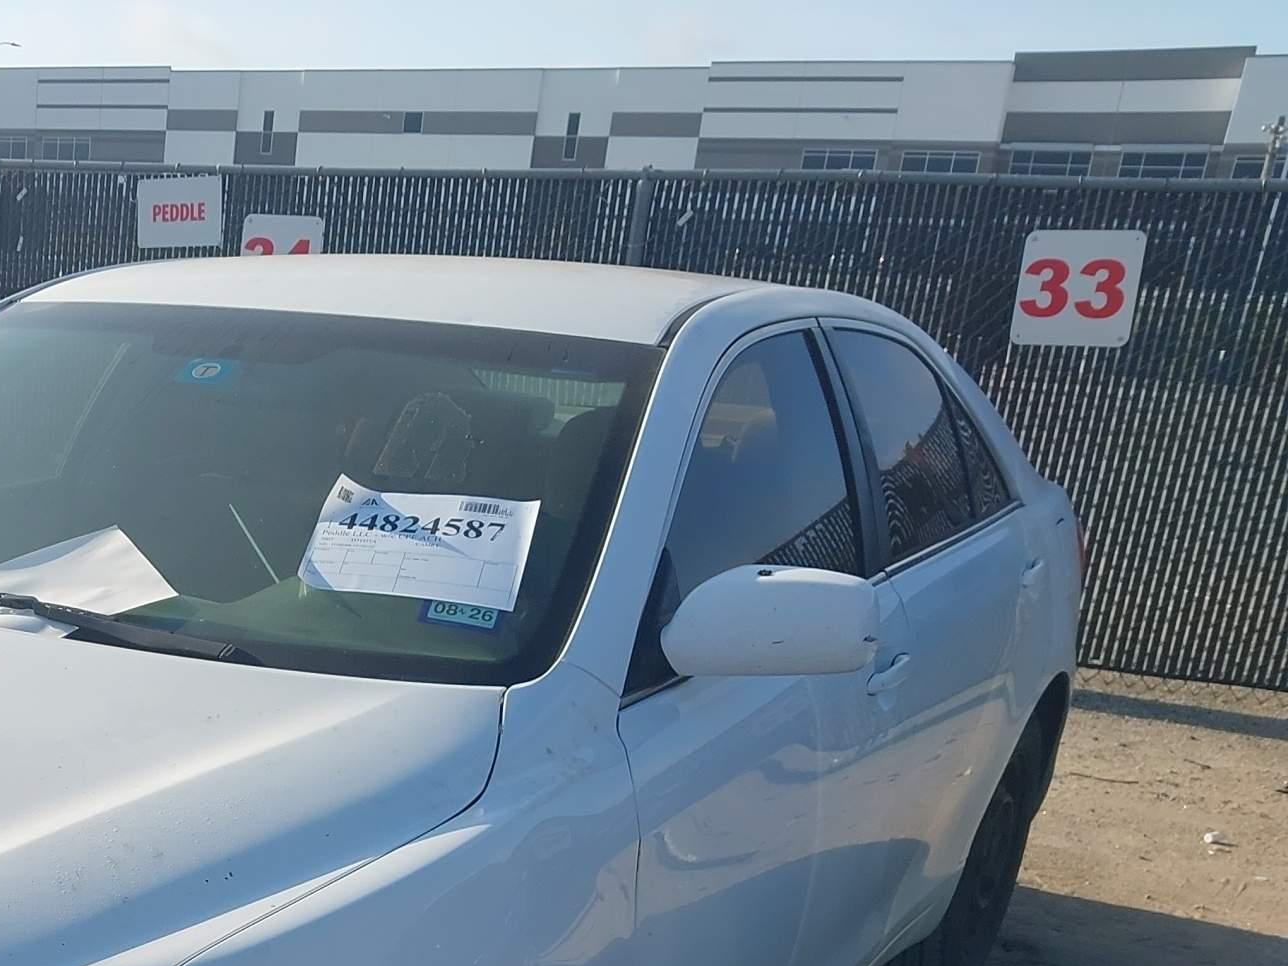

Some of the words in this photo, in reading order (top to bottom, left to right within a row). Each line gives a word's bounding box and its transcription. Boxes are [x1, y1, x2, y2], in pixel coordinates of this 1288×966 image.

[152, 202, 206, 223] PEDDLE
[1018, 258, 1126, 319] 33
[339, 512, 506, 542] 44824587
[434, 601, 459, 616] 08
[468, 607, 494, 622] 26
